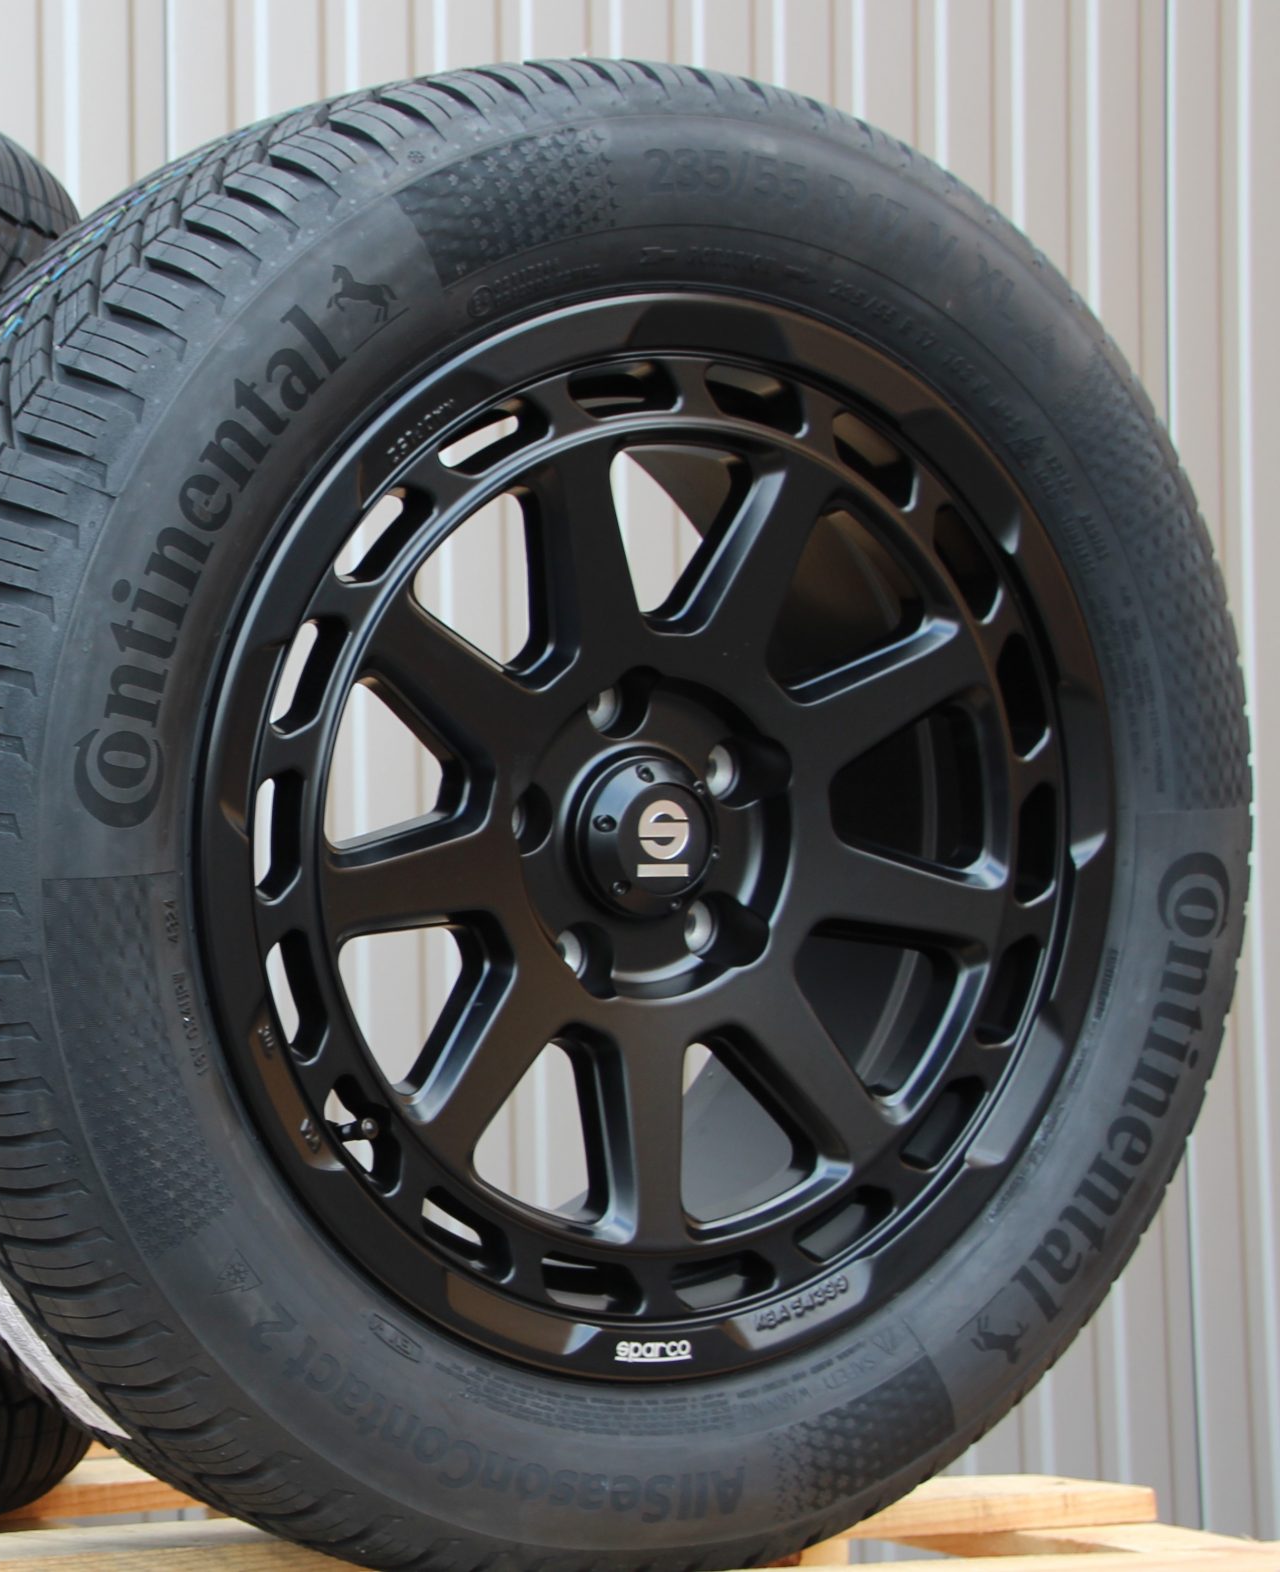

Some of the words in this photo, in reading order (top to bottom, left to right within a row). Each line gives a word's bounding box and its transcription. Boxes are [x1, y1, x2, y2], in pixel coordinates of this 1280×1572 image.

[643, 148, 808, 202] 235/55
[73, 304, 347, 829] Continental
[1010, 852, 1230, 1324] Continental
[245, 1300, 300, 1355] 2
[616, 1340, 691, 1362] sparco
[283, 1331, 745, 1523] AllSeasonContact
